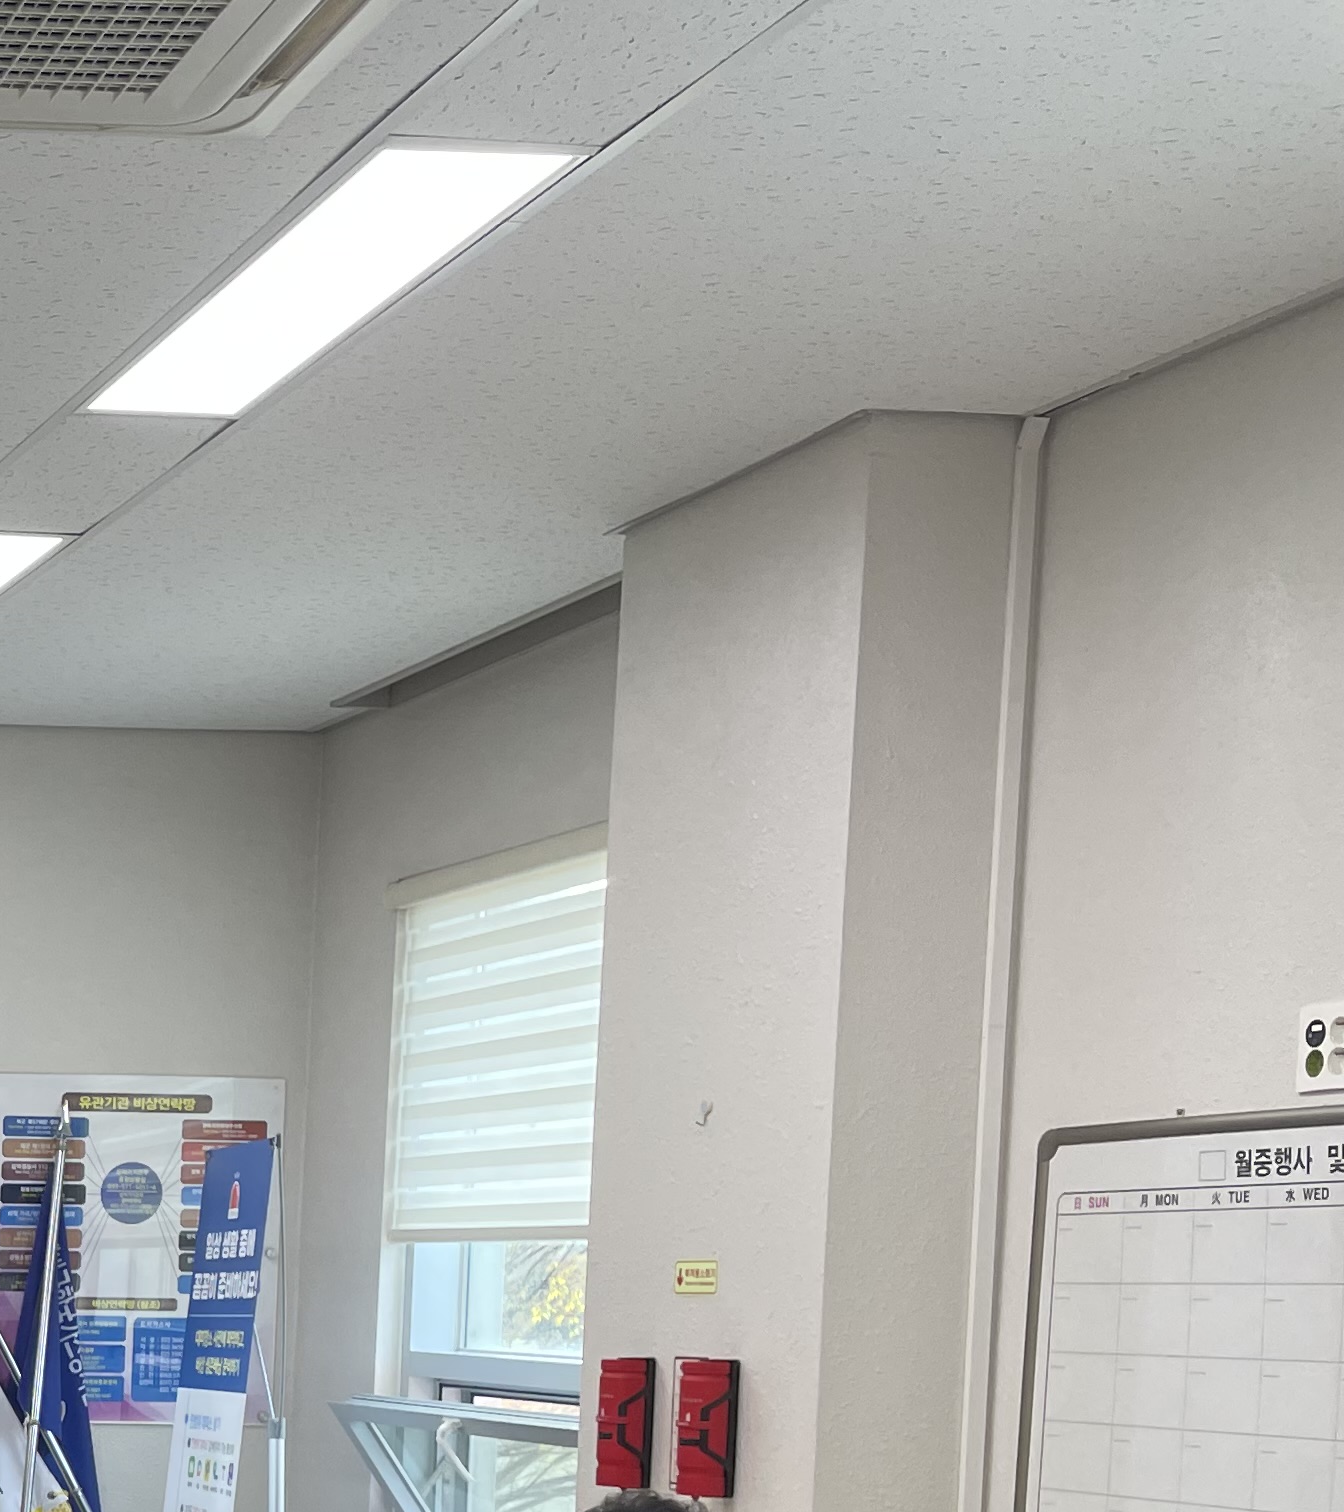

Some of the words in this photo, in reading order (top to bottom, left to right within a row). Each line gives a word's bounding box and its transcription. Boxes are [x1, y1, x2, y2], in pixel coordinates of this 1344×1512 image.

[79, 1096, 129, 1110] 유관기관
[133, 1097, 197, 1111] 비상연락망
[1234, 1145, 1313, 1178] 월중행사
[1155, 1192, 1179, 1207] MON
[1228, 1189, 1250, 1204] TUE
[1302, 1187, 1330, 1201] WED
[1088, 1195, 1110, 1210] SUN
